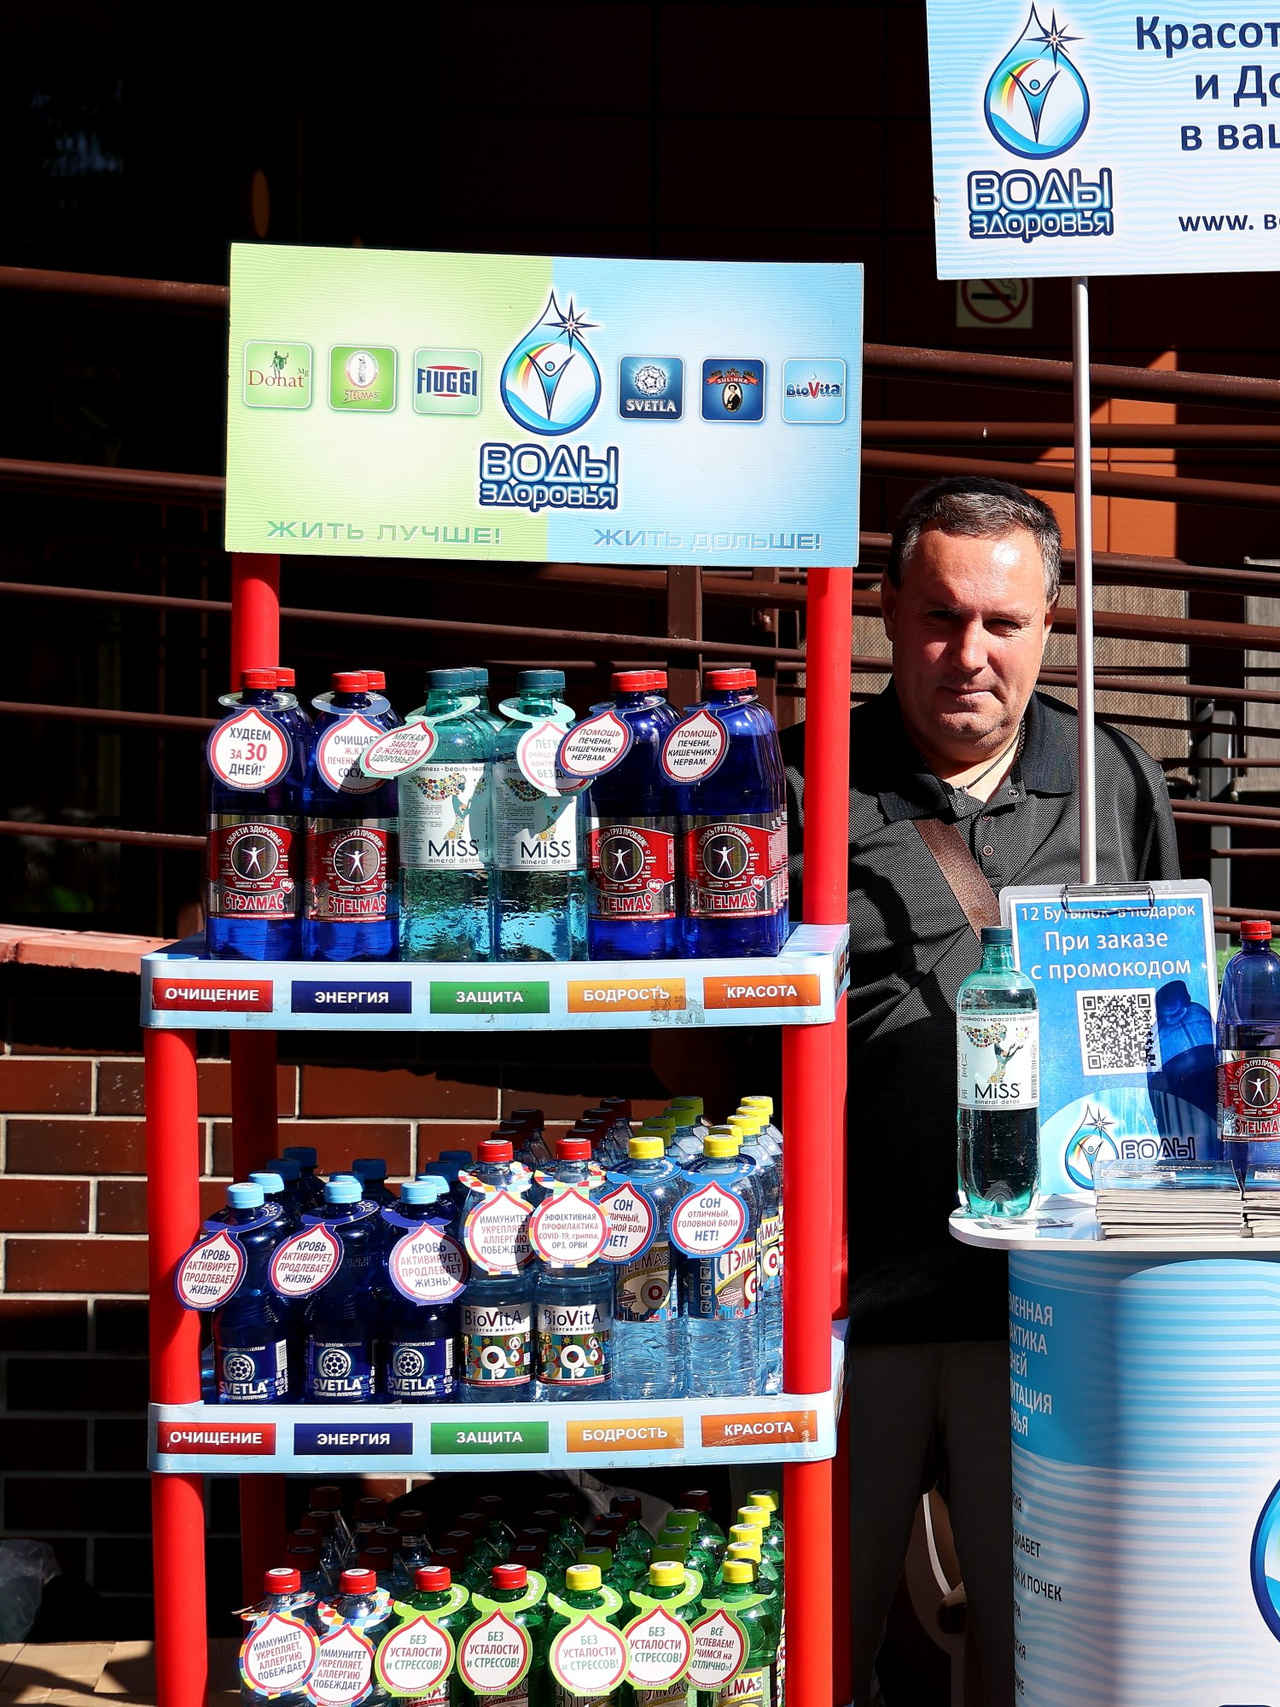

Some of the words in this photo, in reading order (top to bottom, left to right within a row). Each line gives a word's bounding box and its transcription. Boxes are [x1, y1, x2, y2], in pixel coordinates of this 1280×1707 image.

[1194, 75, 1221, 99] и
[1180, 127, 1202, 151] в
[969, 168, 1112, 212] ВОДЫ
[248, 370, 305, 388] Donat
[417, 367, 477, 397] FIUGGI
[716, 375, 750, 385] SULINKA
[343, 389, 379, 402] STELMAS
[786, 381, 842, 399] BioVita
[625, 399, 677, 413] SVETLA
[481, 445, 619, 484] ВОДЫ
[266, 521, 365, 542] ЖИТЬ
[377, 524, 502, 545] ЛУЧШЕ!
[593, 528, 682, 548] ЖИТЬ
[691, 532, 823, 552] ДОЛЬШЕ!
[229, 727, 271, 741] ХУДЕЕМ
[393, 732, 427, 741] МЯГКАЯ
[579, 728, 621, 738] ПОМОЩЬ
[677, 729, 718, 738] ПОМОЩЬ
[578, 737, 612, 746] ПЕЧЕНИ,
[677, 739, 711, 748] ПЕЧЕНИ,
[230, 749, 242, 760] ЗА
[245, 743, 267, 761] 30
[382, 748, 421, 756] ЖЕНСКОМ
[566, 745, 619, 754] КИШЕЧНИКУ,
[668, 748, 718, 758] КИШЕЧНИКУ,
[370, 754, 414, 764] ЗДОРОВЬЕ!
[571, 754, 607, 763] НЕРВАМ.
[673, 757, 708, 766] НЕРВАМ.
[537, 769, 554, 779] БЕЗ
[226, 826, 249, 846] ОБРЕТИ
[428, 839, 479, 857] MiSS
[521, 840, 571, 858] MiSS
[649, 881, 662, 890] Mg
[752, 878, 766, 887] Mg
[223, 891, 284, 910] СТЭЛМАС
[328, 895, 387, 913] STELMAS
[700, 891, 757, 910] STELMAS
[1021, 907, 1039, 921] 12
[1130, 905, 1196, 920] подарок
[1044, 931, 1090, 956] При
[1096, 932, 1168, 949] заказе
[1031, 965, 1042, 980] с
[1049, 960, 1191, 984] промокодом
[165, 986, 260, 1003] ОЧИЩЕНИЕ
[314, 989, 390, 1005] ЭНЕРГИЯ
[456, 989, 524, 1005] ЗАЩИТА
[583, 986, 670, 1003] БОДРОСТЬ
[726, 984, 798, 999] КРАСОТА
[974, 1083, 1020, 1099] MiSS
[1121, 1137, 1197, 1160] ВОДЫ
[613, 1198, 633, 1211] СОН
[700, 1197, 721, 1209] СОН
[480, 1214, 529, 1224] ИММУНИТЕТ
[544, 1213, 597, 1221] ЭФФЕКТИВНАЯ
[687, 1209, 730, 1218] ОТЛИЧНЫЙ,
[481, 1224, 528, 1235] УКРЕПЛЯЕТ,
[541, 1222, 599, 1231] ПРОФИЛАКТИКА
[628, 1224, 646, 1233] БОЛИ
[678, 1219, 721, 1228] ГОЛОВНОЙ
[722, 1219, 738, 1227] БОЛИ
[484, 1235, 527, 1244] АЛЛЕРГИЮ
[538, 1232, 570, 1240] COVID-19,
[572, 1234, 600, 1242] гриппа,
[609, 1234, 629, 1247] НЕТ!
[694, 1230, 719, 1241] НЕТ!
[297, 1240, 327, 1252] КРОВЬ
[411, 1242, 446, 1254] КРОВЬ
[481, 1244, 530, 1255] ПОБЕЖДАЕТ
[551, 1241, 567, 1249] ОРЗ,
[569, 1240, 588, 1249] ОРВИ
[201, 1249, 231, 1261] КРОВЬ
[281, 1251, 332, 1264] АКТИВИРУЕТ,
[400, 1252, 461, 1265] АКТИВИРУЕТ,
[186, 1261, 237, 1274] АКТИВИРУЕТ,
[277, 1262, 330, 1274] ПРОДЛЕВАЕТ
[402, 1263, 462, 1277] ПРОДЛЕВАЕТ
[183, 1272, 234, 1285] ПРОДЛЕВАЕТ
[282, 1272, 316, 1284] ЖИЗНЬ!
[414, 1275, 451, 1288] ЖИЗНЬ!
[189, 1284, 221, 1296] ЖИЗНЬ!
[465, 1309, 521, 1327] BioVitA
[544, 1308, 602, 1327] BioVitA
[219, 1381, 268, 1395] SVETLA
[313, 1378, 362, 1391] SVETLA
[388, 1377, 436, 1391] SVETLA
[582, 1425, 668, 1442] БОДРОСТЬ
[724, 1421, 795, 1435] КРАСОТА
[170, 1430, 263, 1447] ОЧИЩЕНИЕ
[316, 1431, 391, 1447] ЭНЕРГИЯ
[456, 1429, 523, 1445] ЗАЩИТА
[1027, 1575, 1063, 1602] ПОЧЕК
[487, 1631, 504, 1642] БЕЗ
[648, 1626, 665, 1637] БЕЗ
[710, 1626, 724, 1637] ВСЁ
[254, 1631, 302, 1652] ИММУНИТЕТ
[410, 1634, 427, 1645] БЕЗ
[581, 1635, 598, 1645] БЕЗ
[629, 1640, 682, 1651] УСТАЛОСТИ
[695, 1637, 734, 1648] УСПЕВАЕМ!
[255, 1641, 303, 1661] УКРЕПЛЯЕТ,
[320, 1648, 367, 1660] ИММУНИТЕТ
[390, 1646, 442, 1658] УСТАЛОСТИ
[469, 1644, 519, 1655] УСТАЛОСТИ
[563, 1647, 617, 1658] УСТАЛОСТИ
[258, 1651, 303, 1671] АЛЛЕРГИЮ
[466, 1659, 473, 1669] и
[474, 1657, 520, 1668] СТРЕССОВ!
[635, 1652, 682, 1663] СТРЕССОВ!
[258, 1660, 307, 1681] ПОБЕЖДАЕТ
[318, 1659, 363, 1671] УКРЕПЛЯЕТ,
[386, 1662, 393, 1671] и
[394, 1659, 442, 1670] СТРЕССОВ!
[562, 1663, 568, 1671] и
[570, 1660, 619, 1671] СТРЕССОВ!
[317, 1669, 361, 1680] АЛЛЕРГИЮ
[313, 1679, 362, 1691] ПОБЕЖДАЕТ
